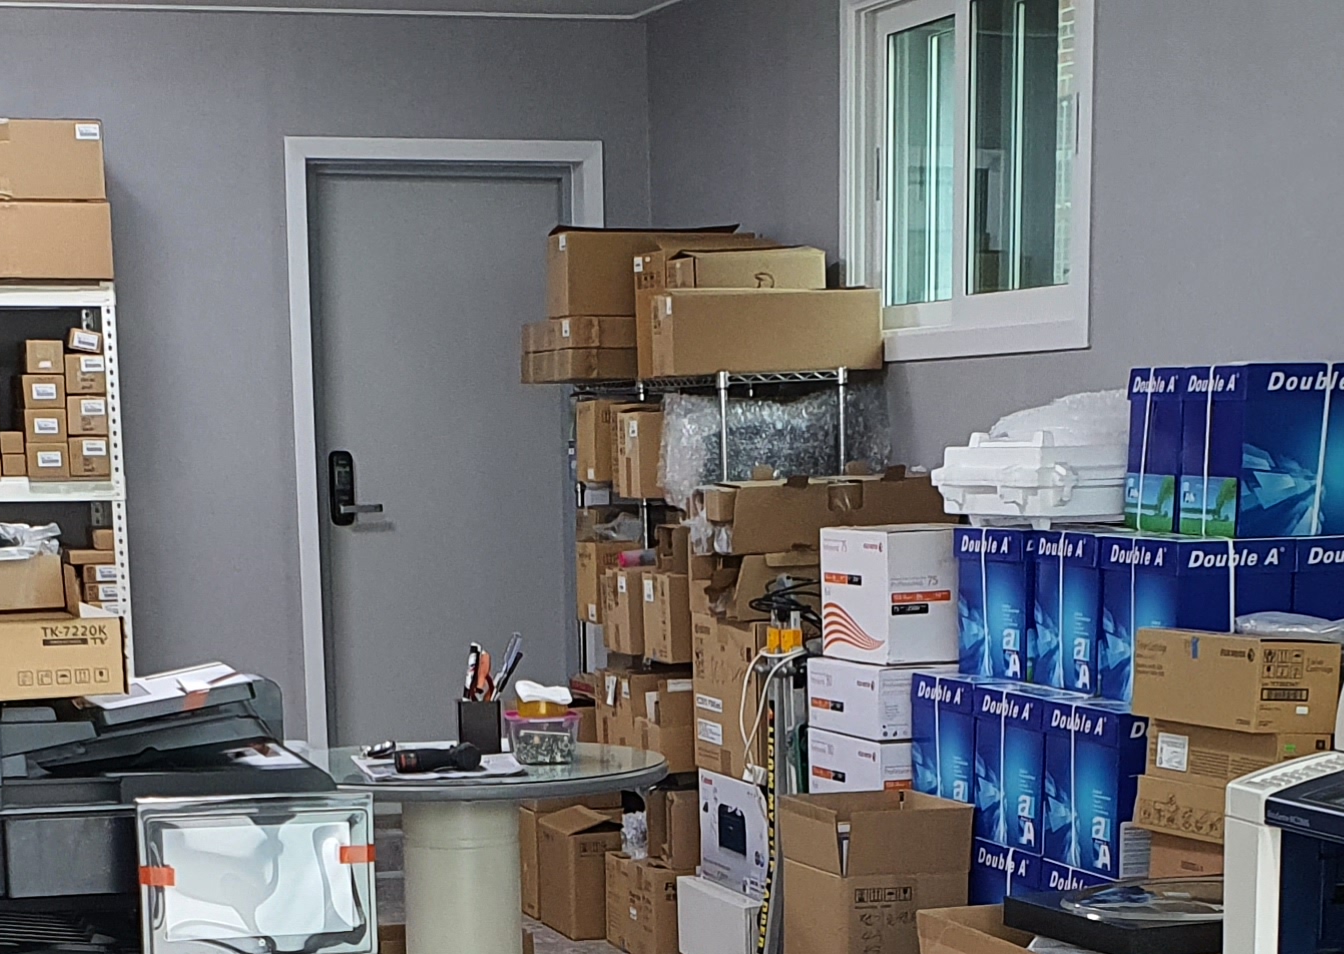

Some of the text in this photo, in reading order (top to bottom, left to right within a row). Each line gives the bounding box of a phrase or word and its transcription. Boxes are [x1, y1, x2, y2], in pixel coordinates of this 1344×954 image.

[1133, 376, 1165, 393] Double
[1038, 537, 1072, 557] Double
[1110, 544, 1151, 565] Double
[1188, 549, 1257, 568] Double
[41, 625, 107, 637] TK-7220K
[918, 681, 951, 703] Double
[982, 695, 1019, 719] Double
[1051, 710, 1091, 734] Double
[1049, 871, 1087, 890] Doubl
